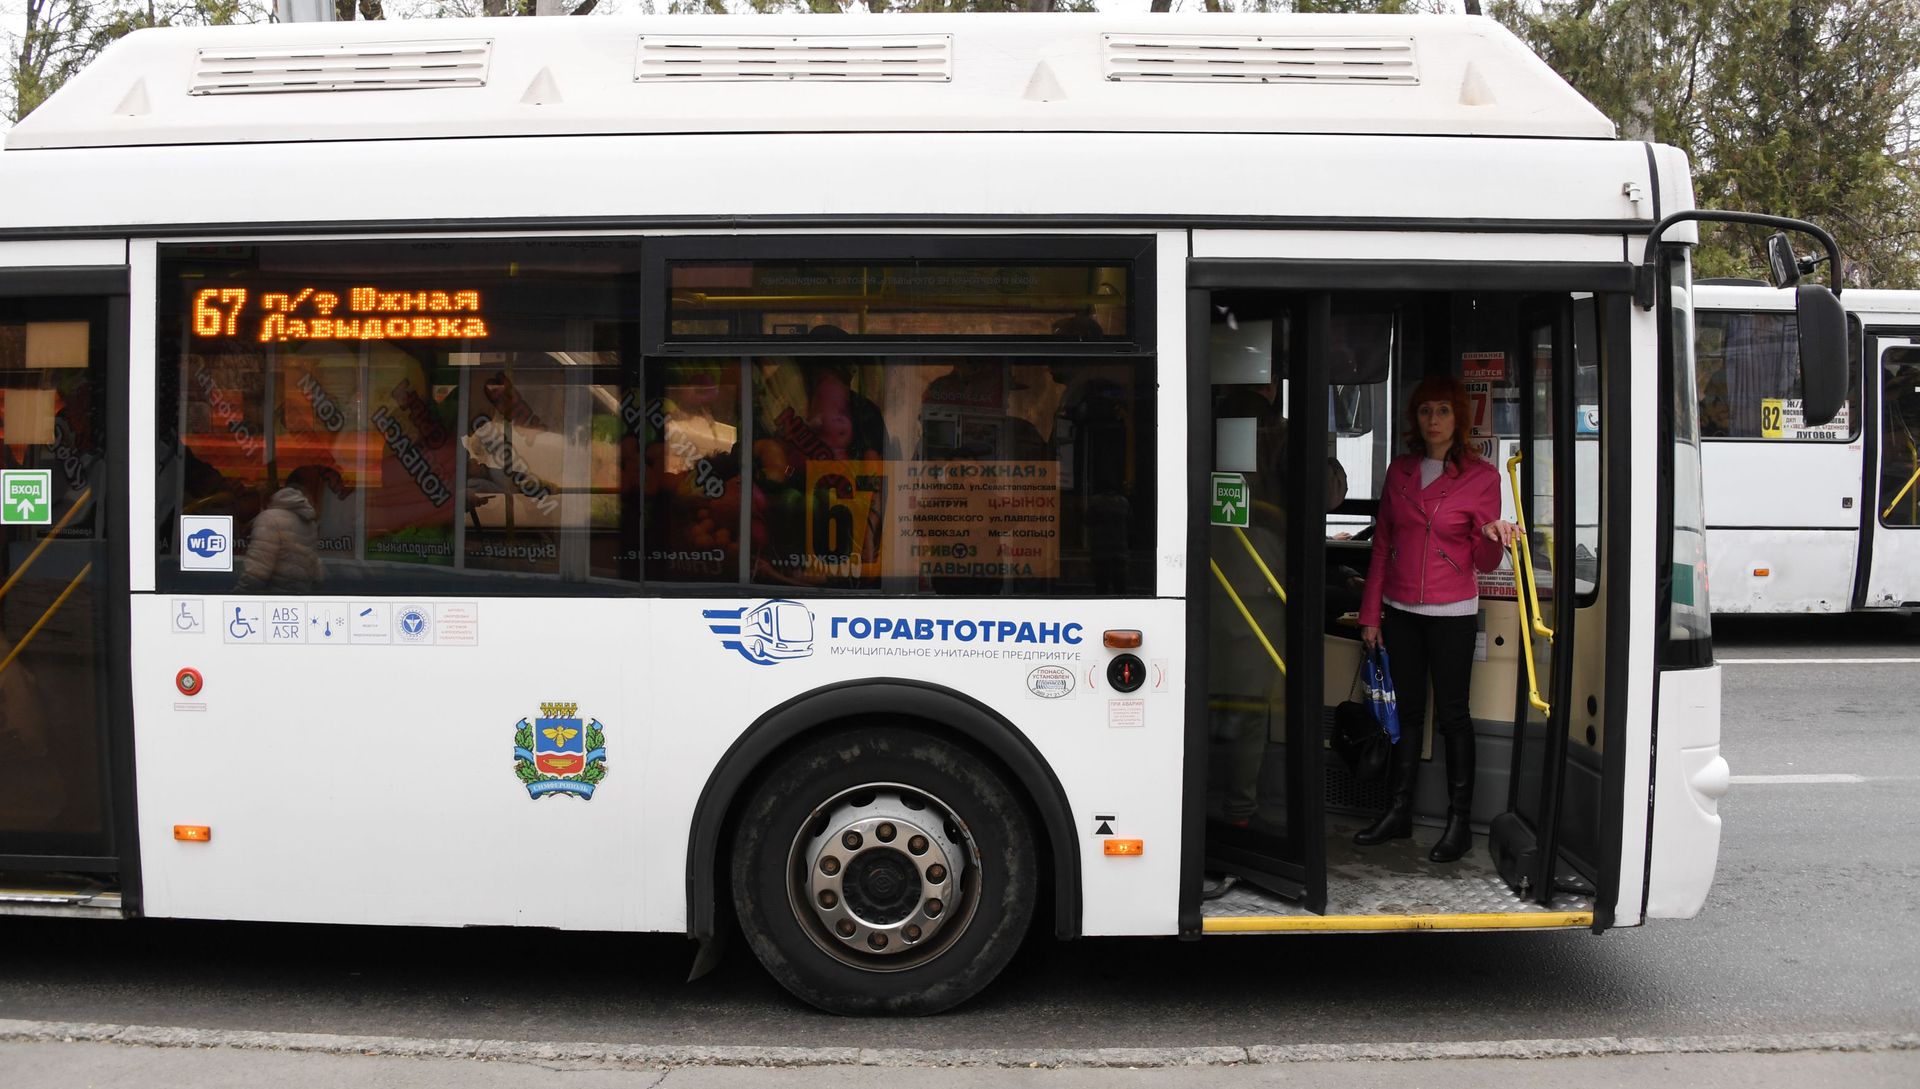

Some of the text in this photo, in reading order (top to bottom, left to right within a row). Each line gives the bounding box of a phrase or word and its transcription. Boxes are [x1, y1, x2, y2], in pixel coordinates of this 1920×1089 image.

[350, 287, 480, 312] Южная
[194, 288, 247, 335] 67
[260, 313, 487, 341] Давыдовка
[1762, 406, 1780, 431] 82
[11, 484, 41, 496] ВХОД
[1218, 487, 1241, 499] ВХОД
[812, 473, 888, 563] 67
[912, 514, 984, 522] МАЯКОВСКОГО
[920, 561, 1033, 576] ДАВЫДОВКА
[1478, 586, 1518, 595] ОНТРОЛЬ
[272, 607, 299, 621] ABS
[272, 625, 299, 639] ASR
[830, 617, 1083, 645] ГОРАВТОТРАНС
[933, 648, 1000, 660] УНИТАРНОЕ
